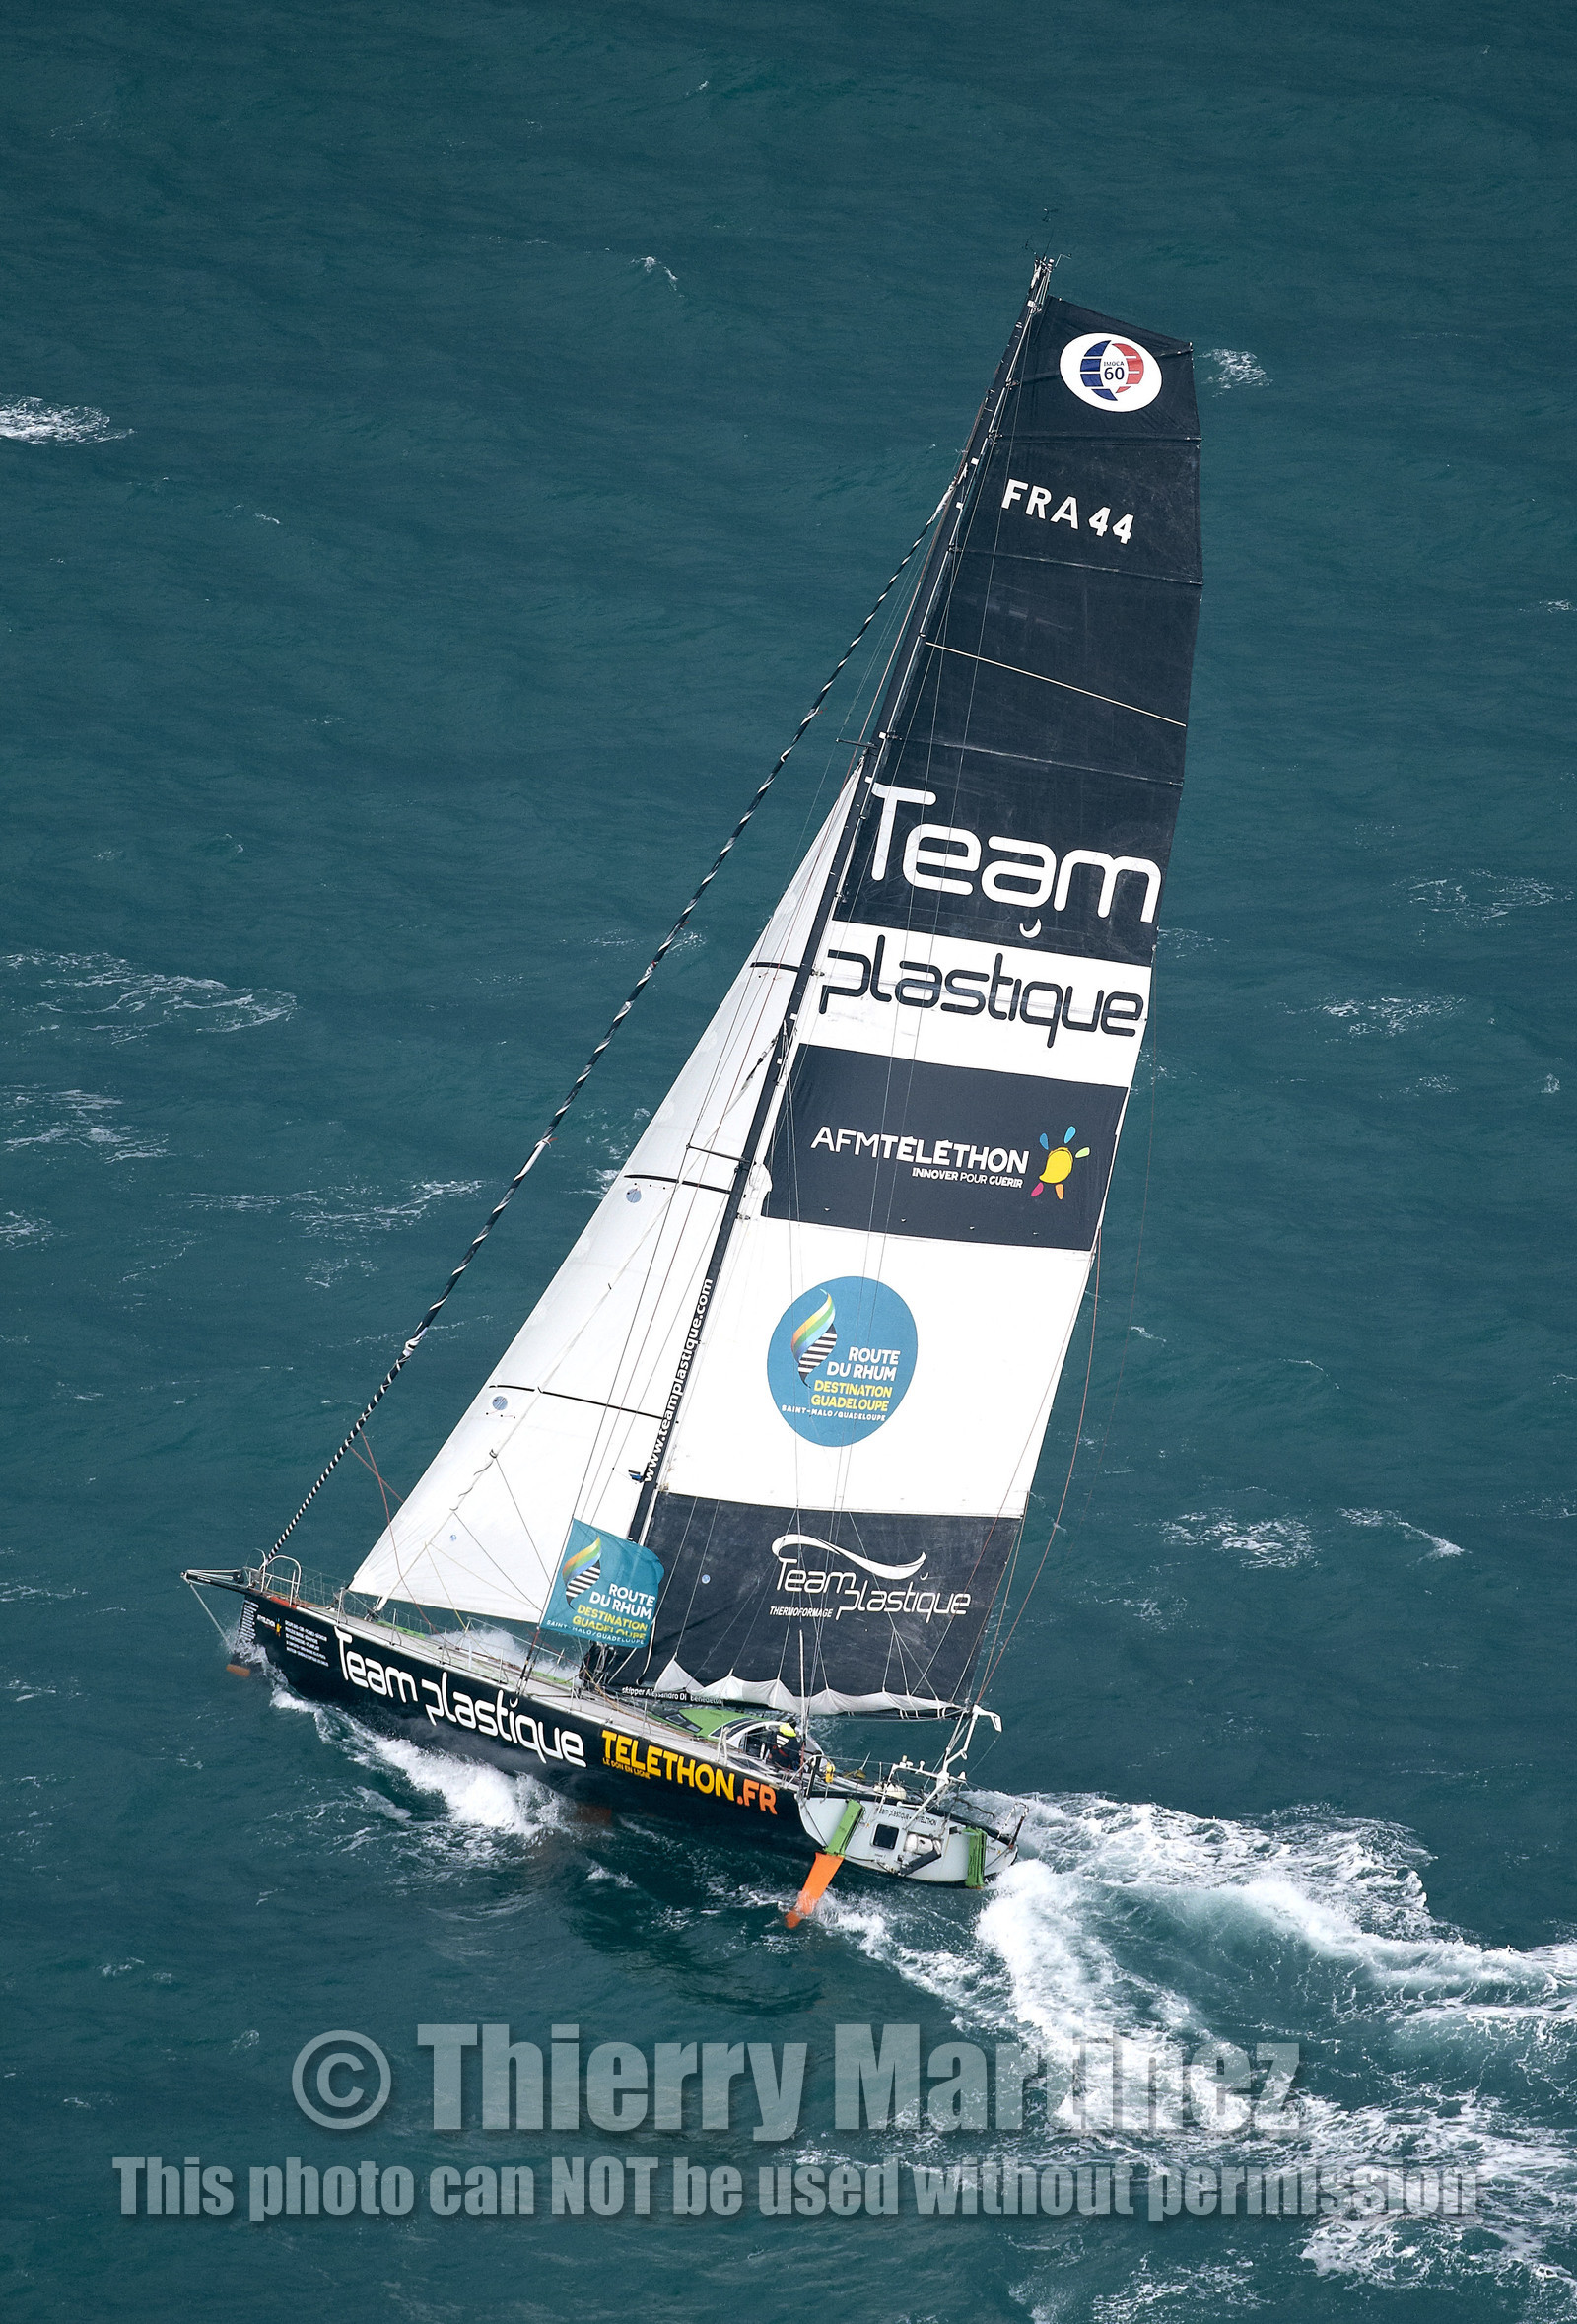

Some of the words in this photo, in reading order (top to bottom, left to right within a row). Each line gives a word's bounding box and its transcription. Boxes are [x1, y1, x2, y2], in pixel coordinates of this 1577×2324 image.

[1104, 366, 1125, 380] 60
[1001, 478, 1079, 530] FRA
[1088, 506, 1134, 544] 44
[870, 782, 1162, 923] Team
[818, 920, 1144, 1049] plastique
[912, 1167, 958, 1182] INNOVER
[960, 1172, 986, 1185] POUR
[848, 1346, 901, 1365] ROUTE
[644, 1278, 714, 1482] www.teamplastique.com
[826, 1361, 852, 1377] DU
[853, 1363, 897, 1382] RHUM
[814, 1380, 893, 1398] DESTINATION
[810, 1394, 889, 1412] GUADELOUPE
[609, 1583, 655, 1607] ROUTE
[777, 1558, 857, 1593] Team
[836, 1572, 971, 1623] plastique
[589, 1591, 611, 1607] DU
[612, 1597, 652, 1620] RHUM
[770, 1606, 833, 1618] THERMOFORMAGE
[577, 1605, 648, 1631] DESTINATION
[334, 1625, 418, 1703] Team
[421, 1671, 587, 1768] plastique
[621, 1686, 645, 1696] skipper
